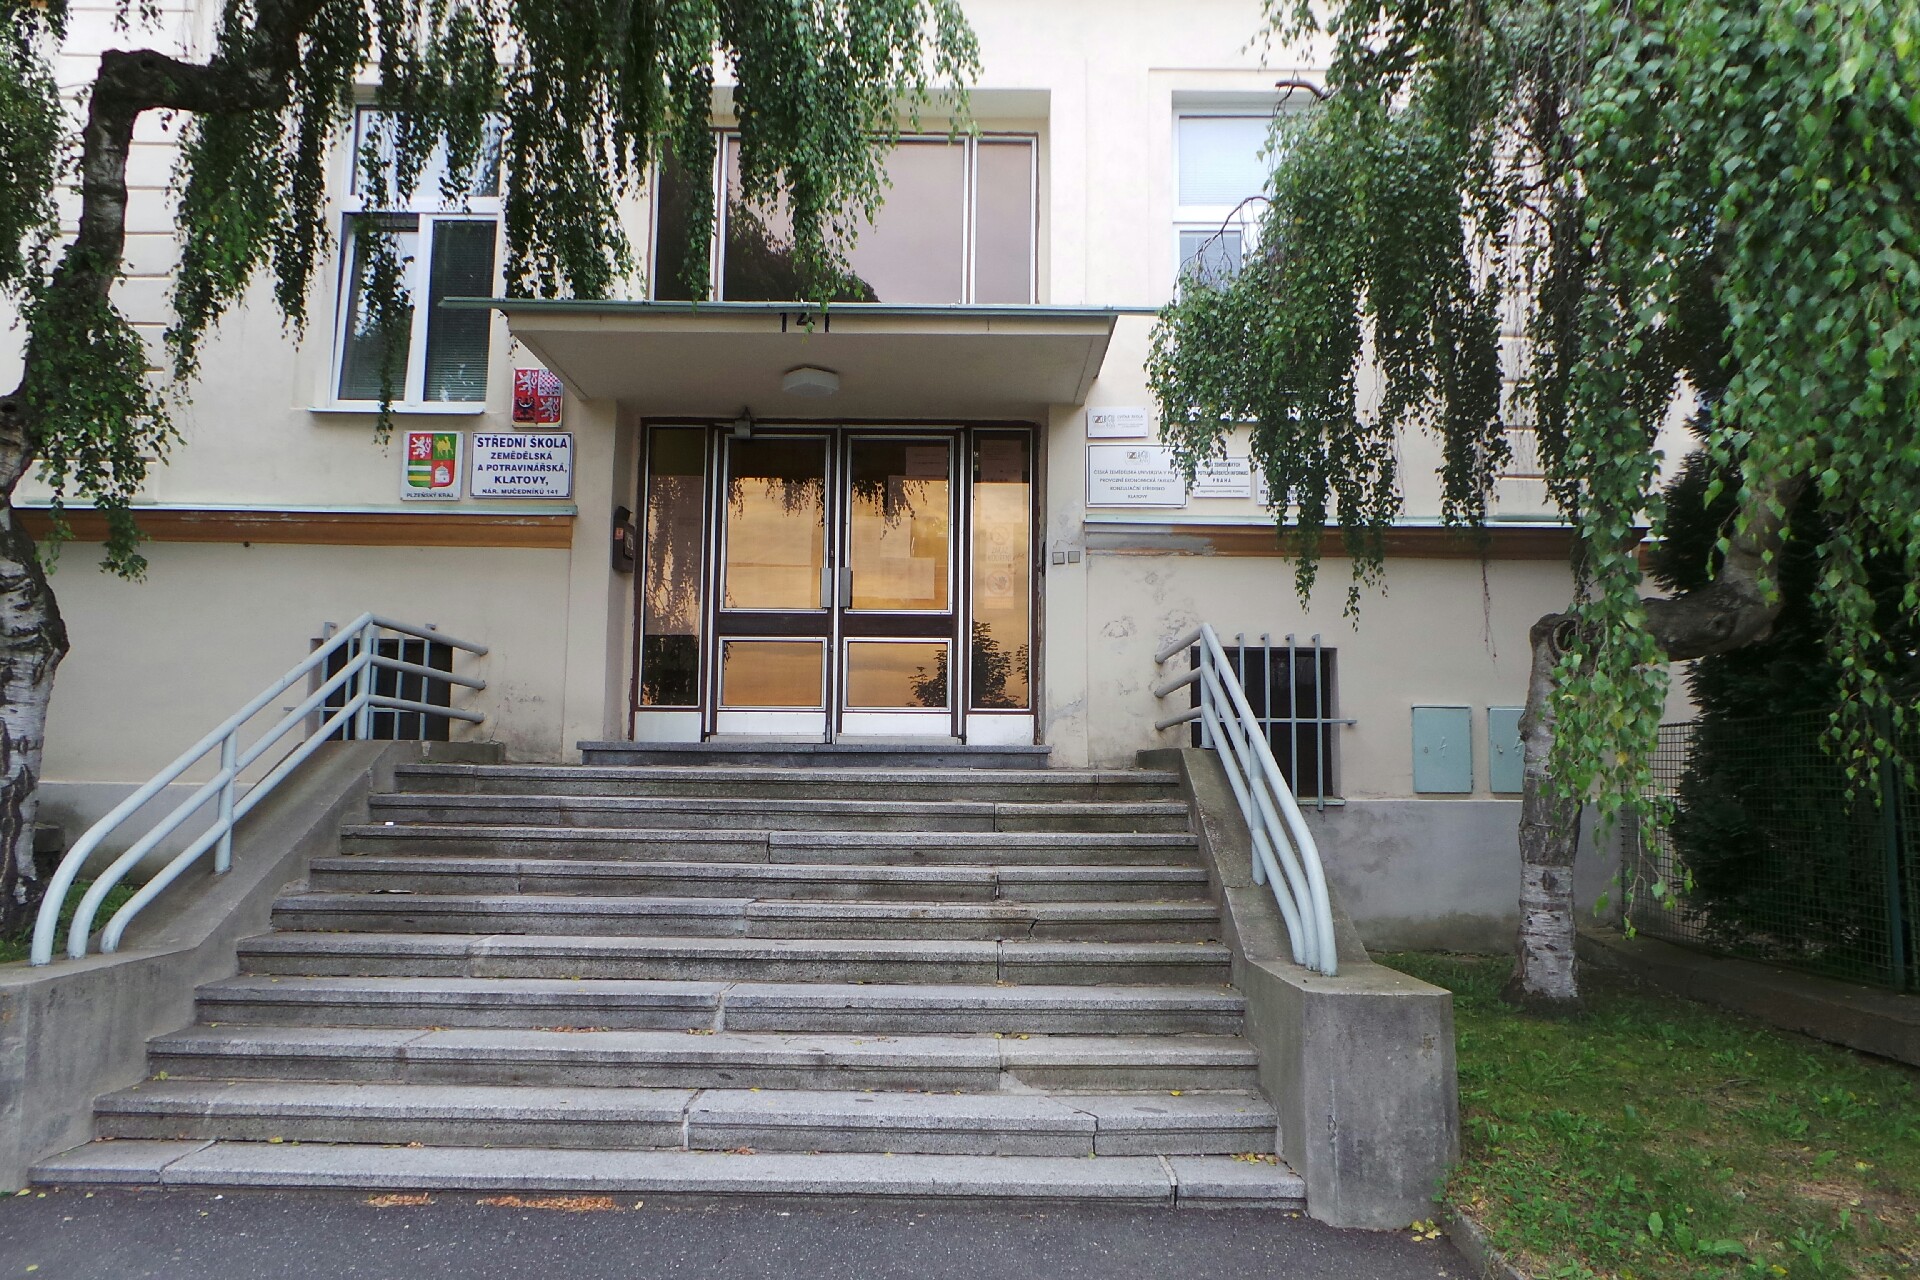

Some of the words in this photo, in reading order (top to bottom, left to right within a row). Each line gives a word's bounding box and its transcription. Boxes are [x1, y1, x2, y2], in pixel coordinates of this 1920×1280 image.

[477, 434, 526, 449] STŘEDNÍ
[529, 434, 568, 449] ŠKOLA
[490, 450, 553, 460] ZEMĚDĚLSKÁ
[485, 462, 568, 473] POTRAVINÁŘSKÁ,
[494, 475, 549, 486] KLATOVY,
[501, 487, 545, 495] MUČEDNÍKŮ
